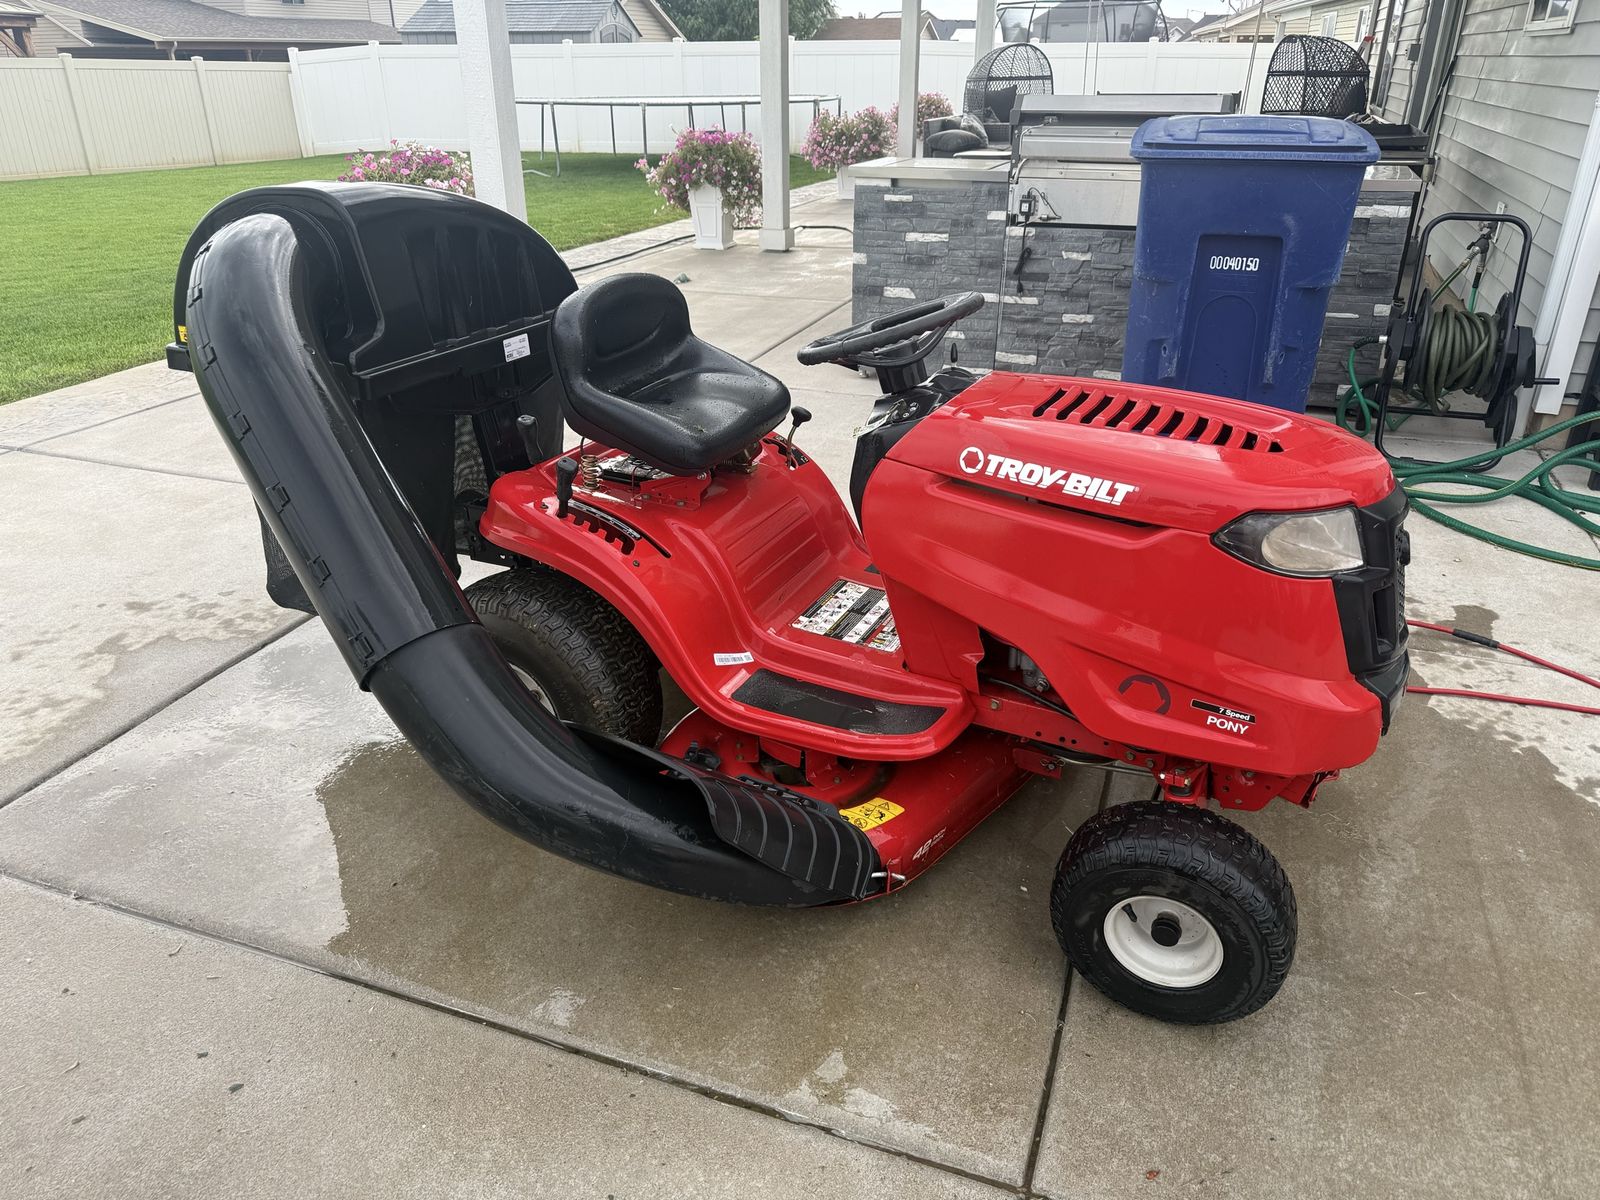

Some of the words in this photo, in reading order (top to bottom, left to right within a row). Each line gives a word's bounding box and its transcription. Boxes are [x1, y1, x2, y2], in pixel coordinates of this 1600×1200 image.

[1209, 255, 1260, 272] 00040150
[985, 453, 1135, 505] TROY-BILT
[1225, 710, 1250, 720] Speed
[1206, 715, 1249, 734] PONY
